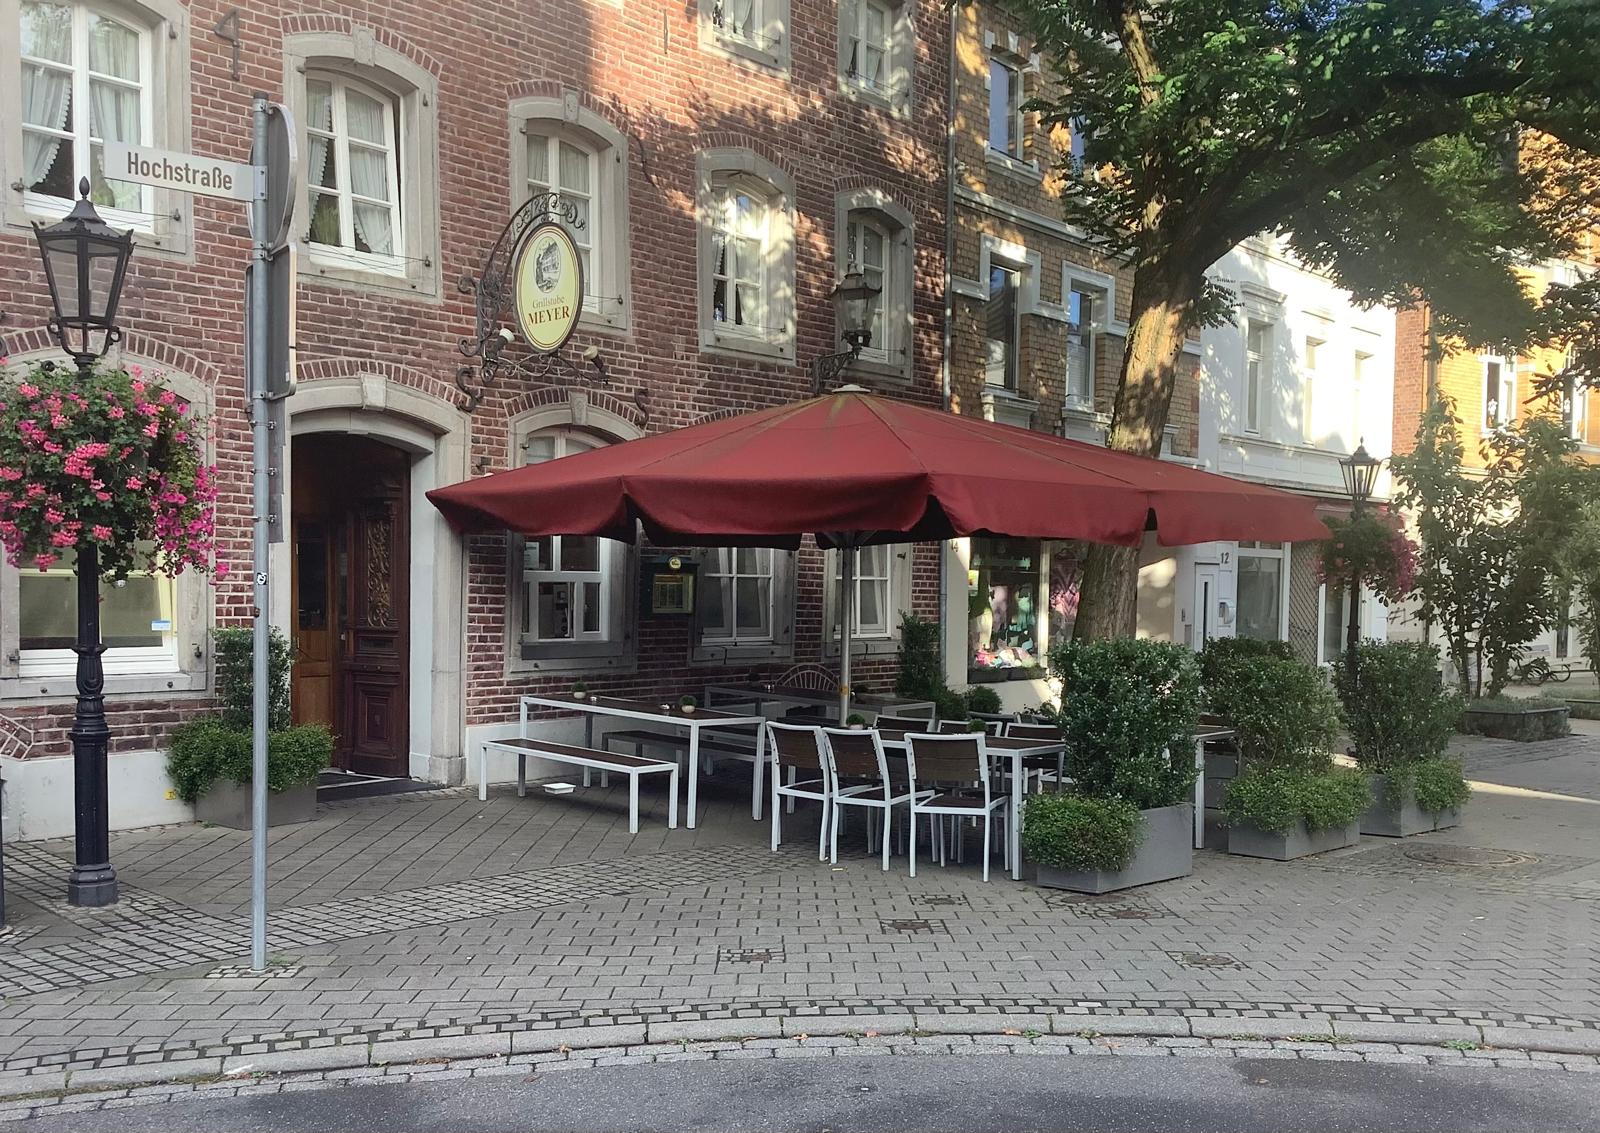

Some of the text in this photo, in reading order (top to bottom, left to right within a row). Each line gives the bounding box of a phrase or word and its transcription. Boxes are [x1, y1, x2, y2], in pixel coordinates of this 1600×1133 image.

[127, 151, 233, 191] Hochstraße
[528, 305, 570, 325] MEYER
[1220, 552, 1230, 565] 12
